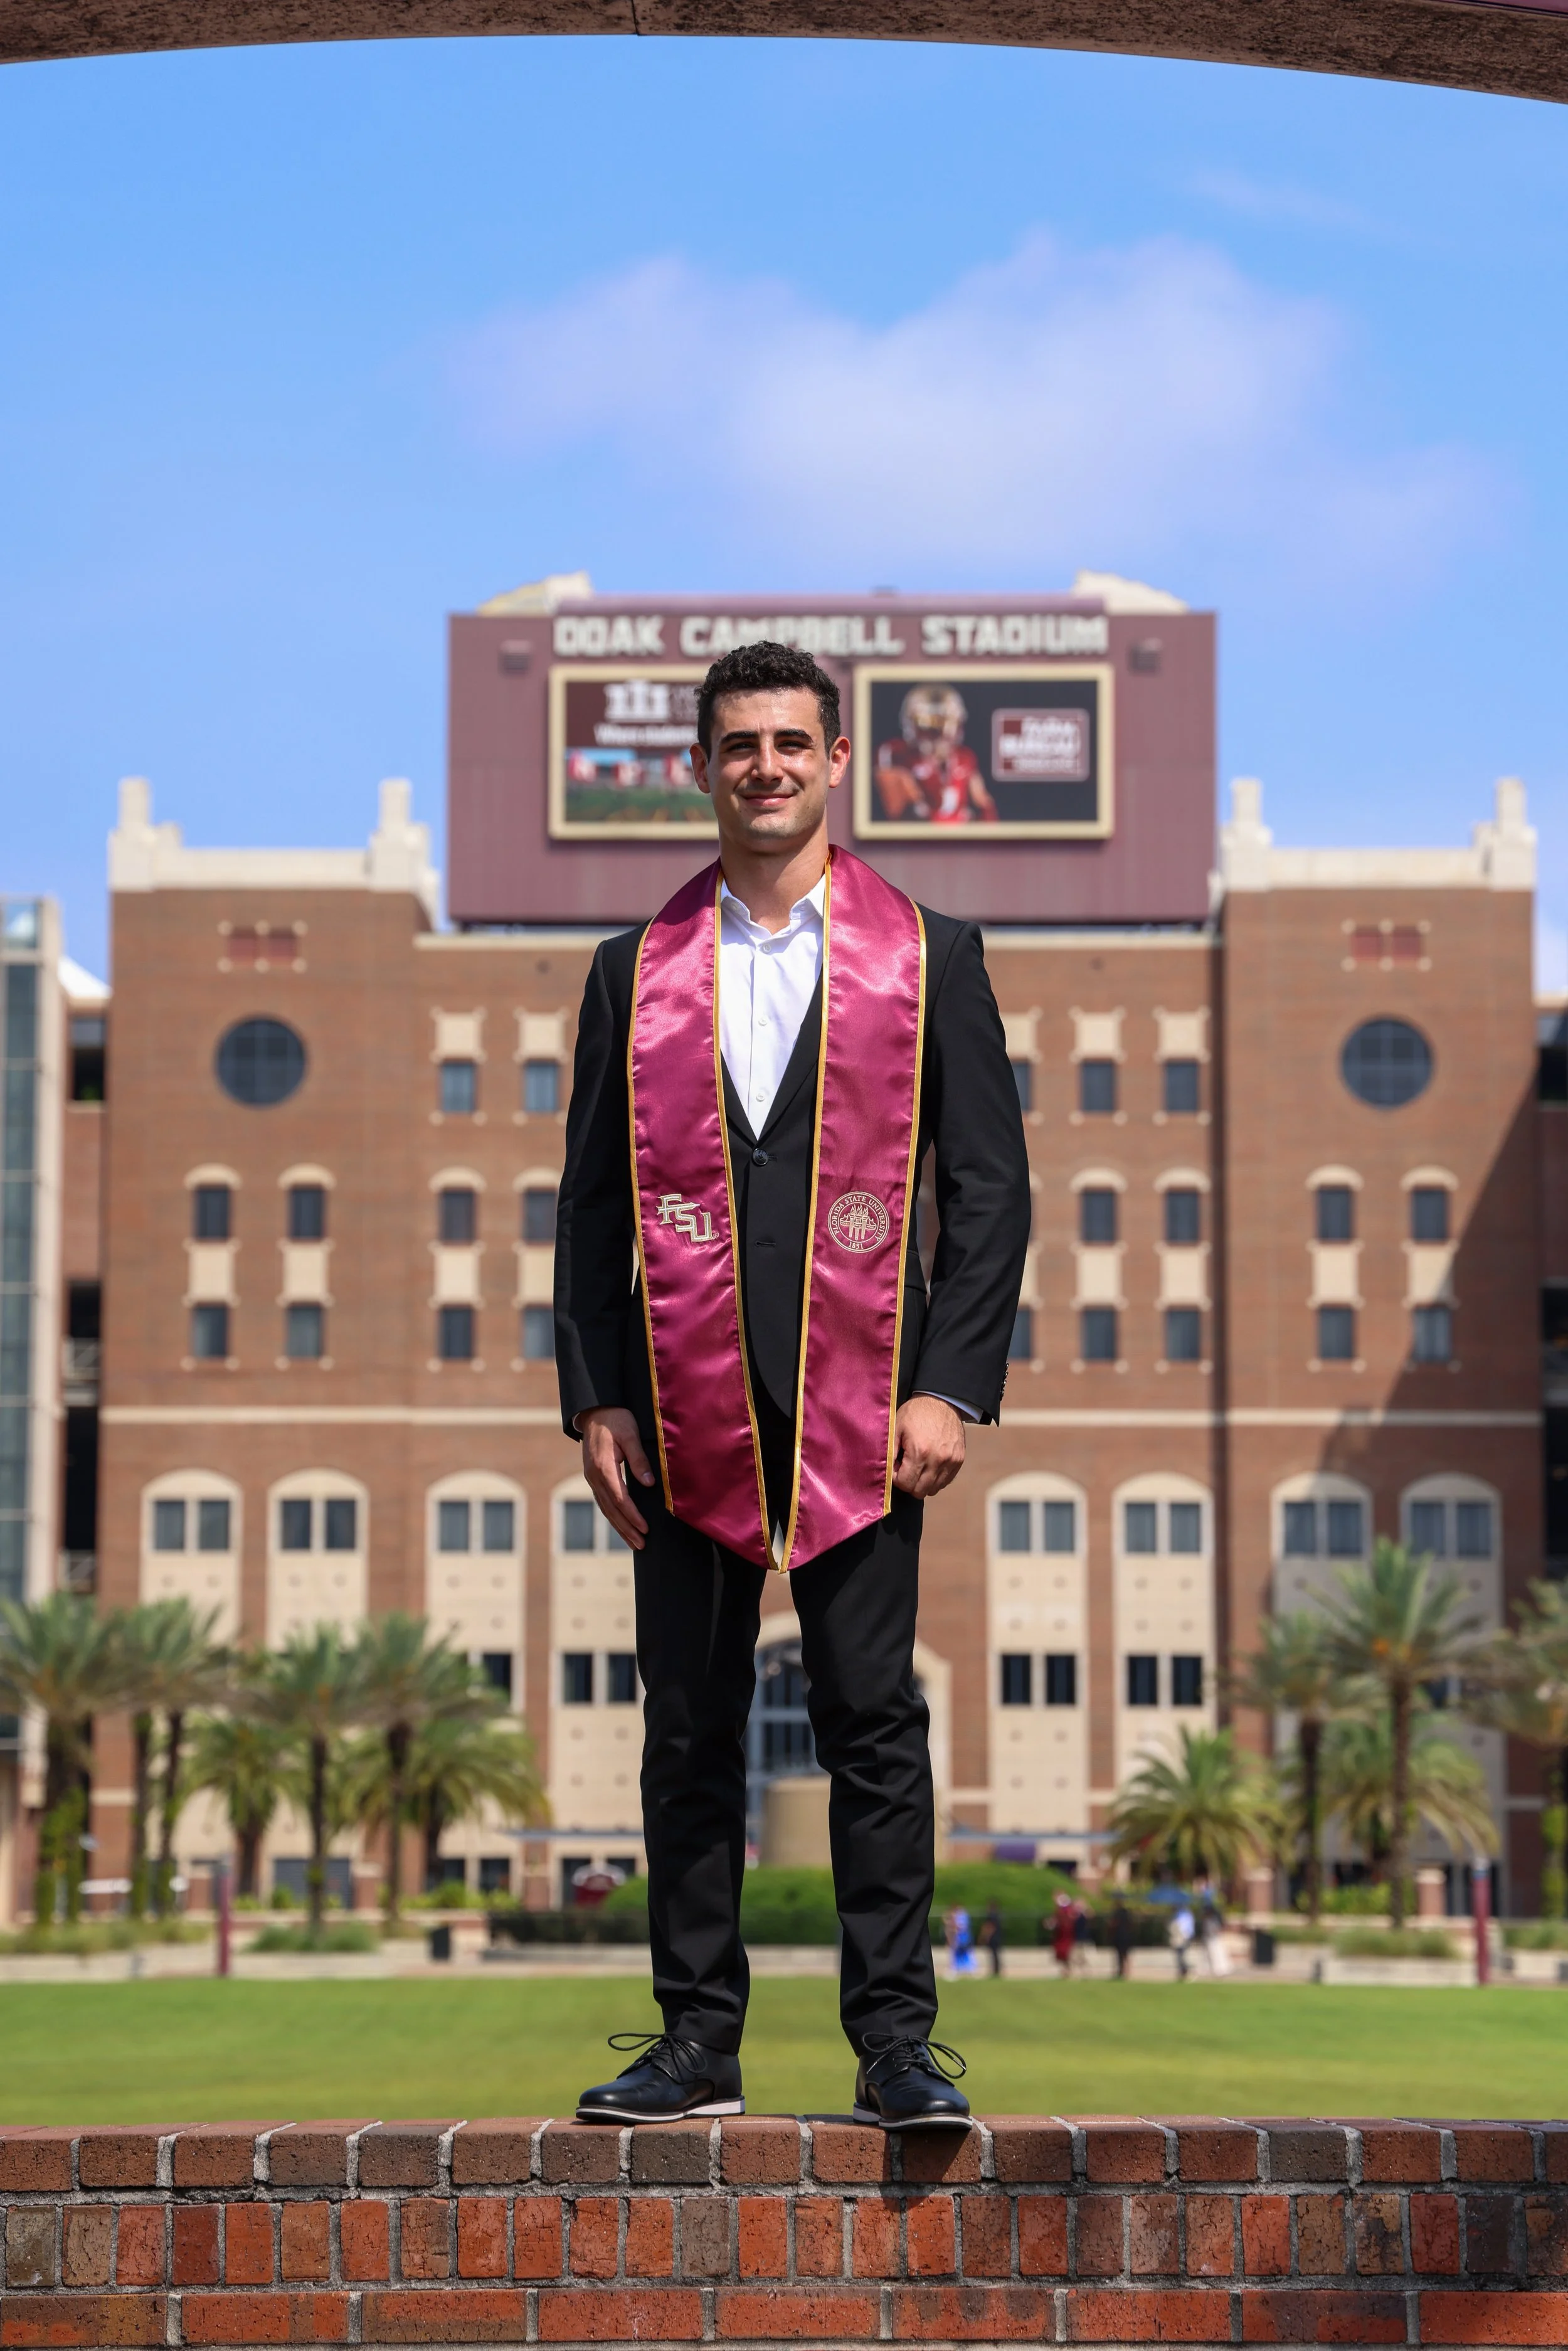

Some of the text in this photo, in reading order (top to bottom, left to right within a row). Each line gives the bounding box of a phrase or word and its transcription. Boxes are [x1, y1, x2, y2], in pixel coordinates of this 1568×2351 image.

[553, 615, 664, 656] DOAK
[921, 614, 1108, 655] STADIUM
[656, 1194, 712, 1242] FSU
[832, 1196, 886, 1241] FLORIDA STATE UNIVERSITY
